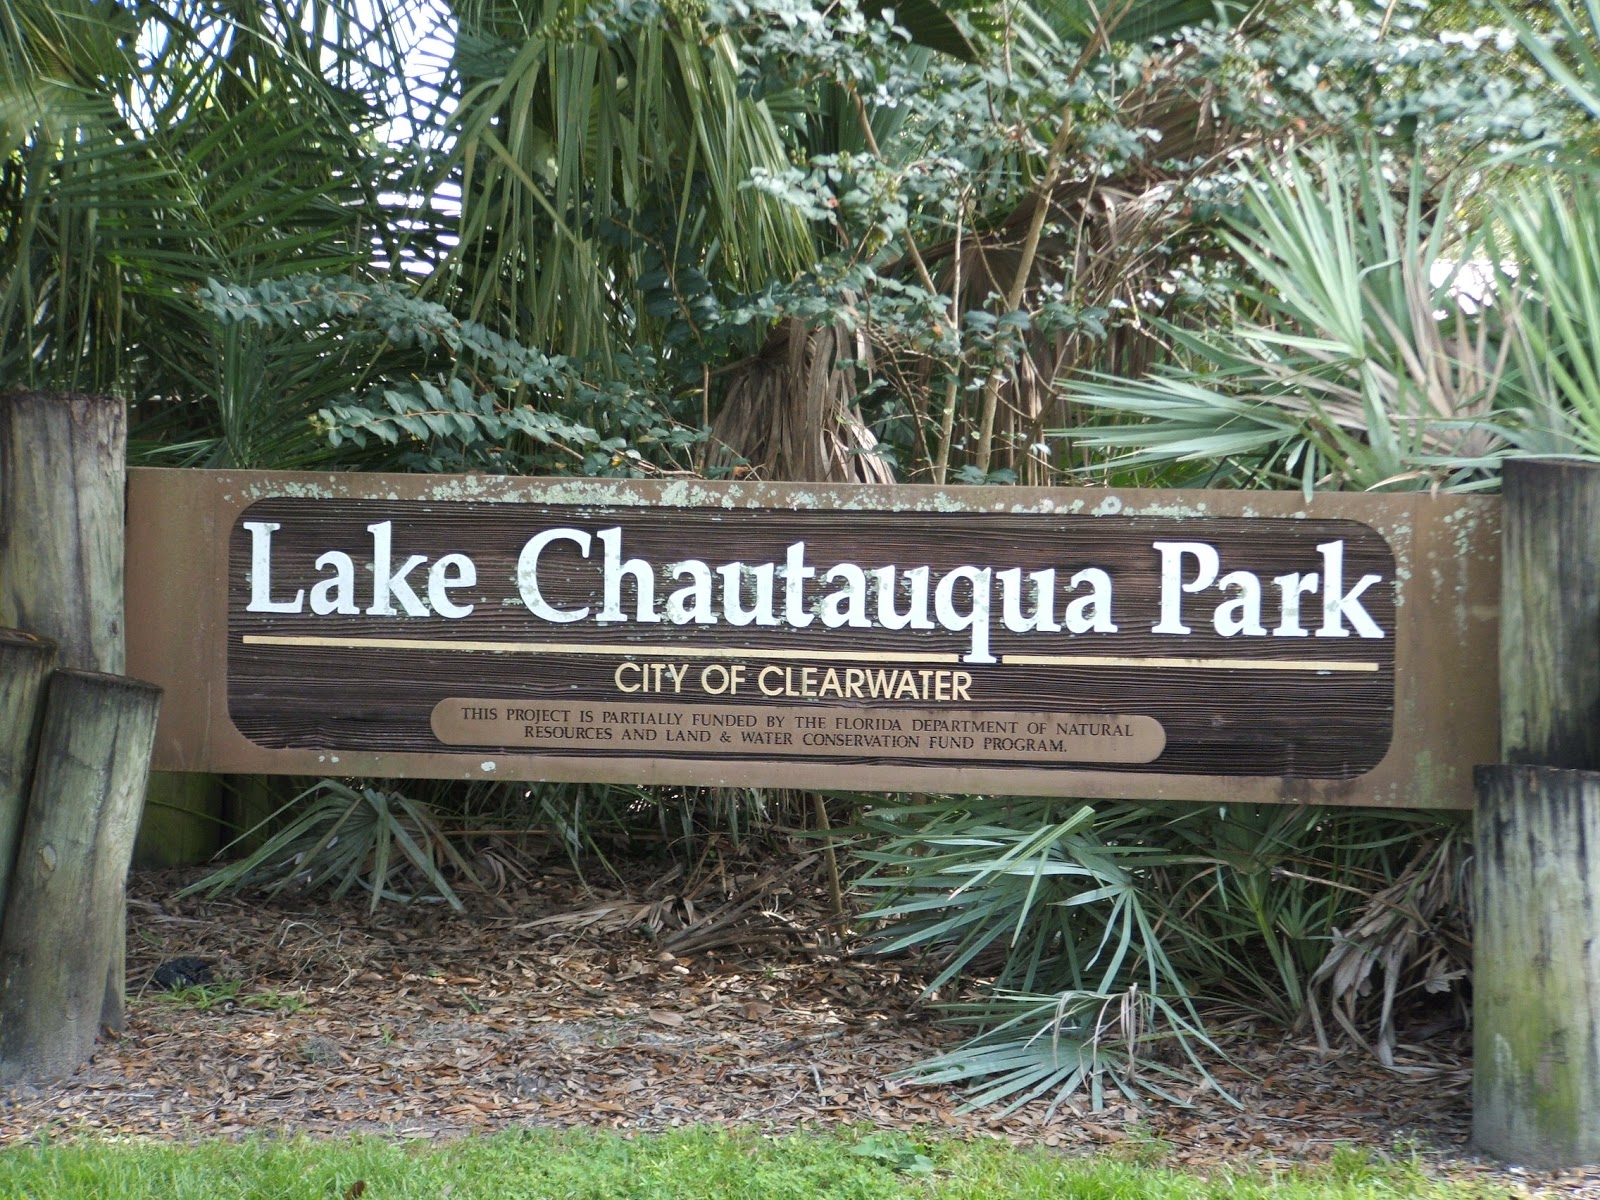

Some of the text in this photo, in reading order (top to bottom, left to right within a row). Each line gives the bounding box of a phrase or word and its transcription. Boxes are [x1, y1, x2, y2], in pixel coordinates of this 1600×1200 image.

[243, 520, 1385, 664] Lake Chautauqua Park
[614, 662, 972, 701] CITY OF CLEARWATER
[461, 707, 1133, 737] THIS PROJECT IS PARTIALLY FUNDED BY THE FLORIDA DEPARTMENT OF NATURAL
[524, 725, 1067, 753] RESOURCES AND LAND & WATER CONSERVATION FUND PROGRAM.
